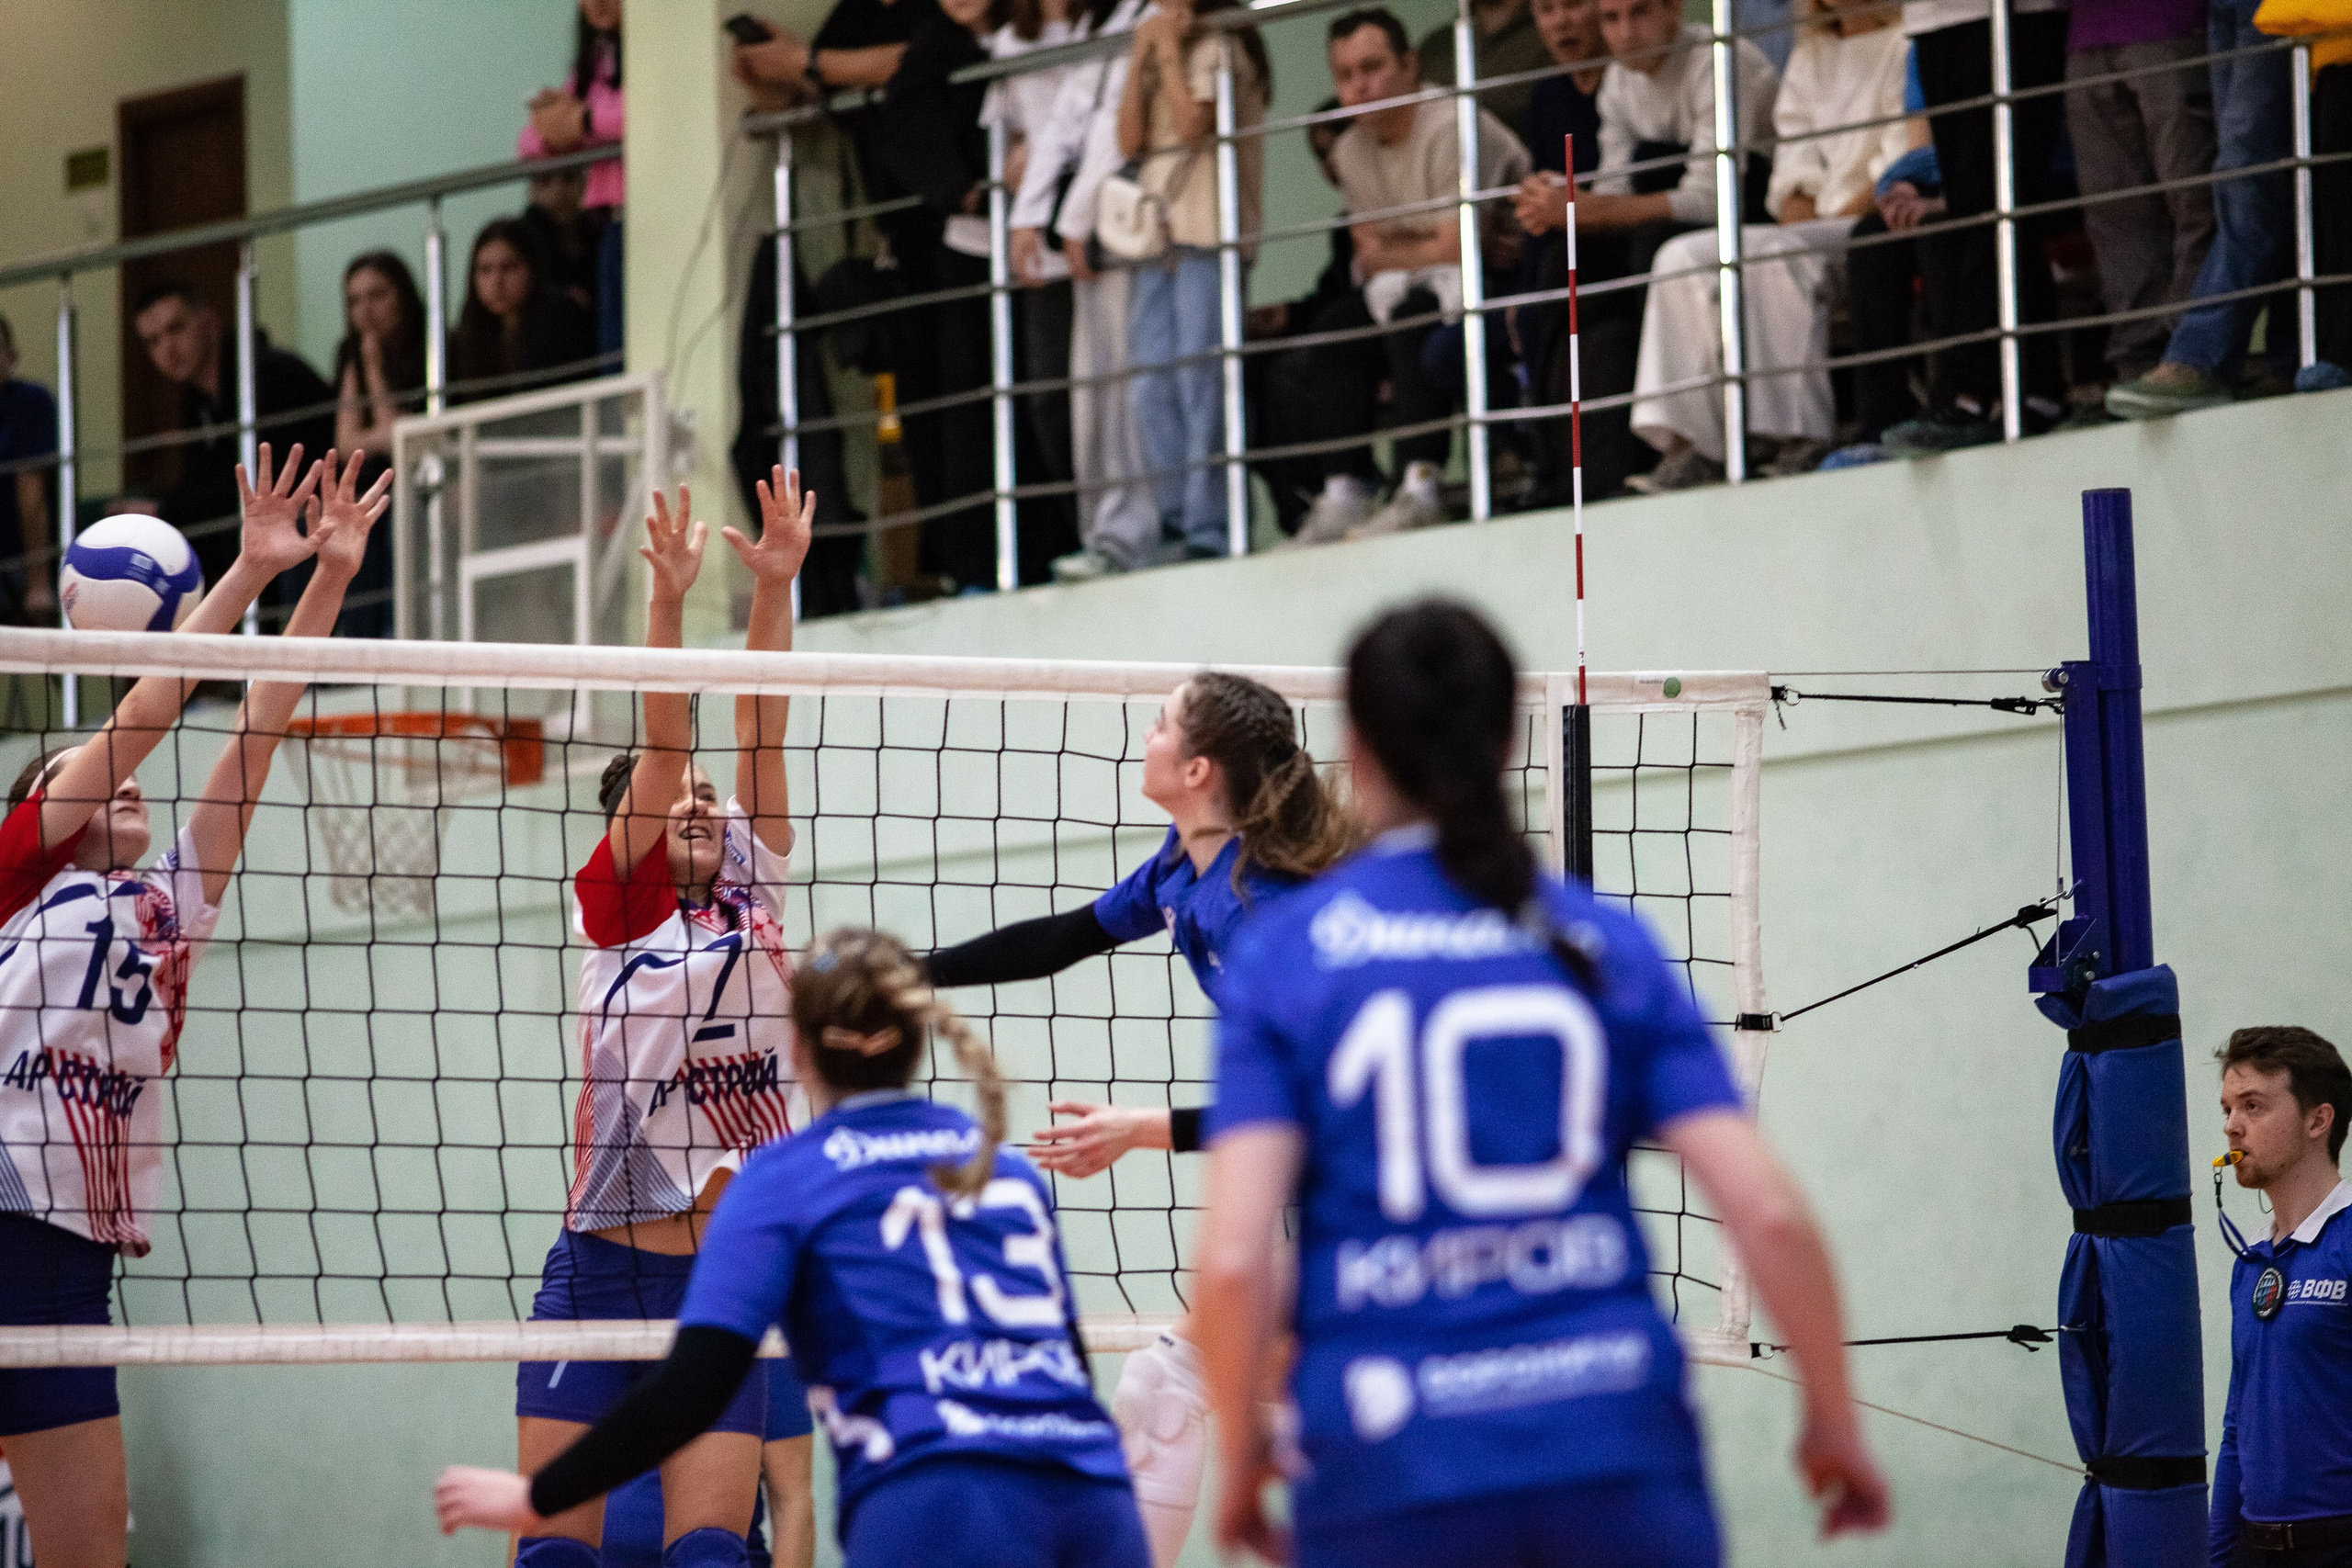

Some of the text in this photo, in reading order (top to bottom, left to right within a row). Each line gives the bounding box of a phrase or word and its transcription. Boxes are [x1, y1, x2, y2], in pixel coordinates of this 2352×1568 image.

[77, 916, 154, 1025] 15
[1327, 987, 1608, 1220] 10
[880, 1177, 1066, 1327] 13
[2300, 1279, 2347, 1300] ВФВ
